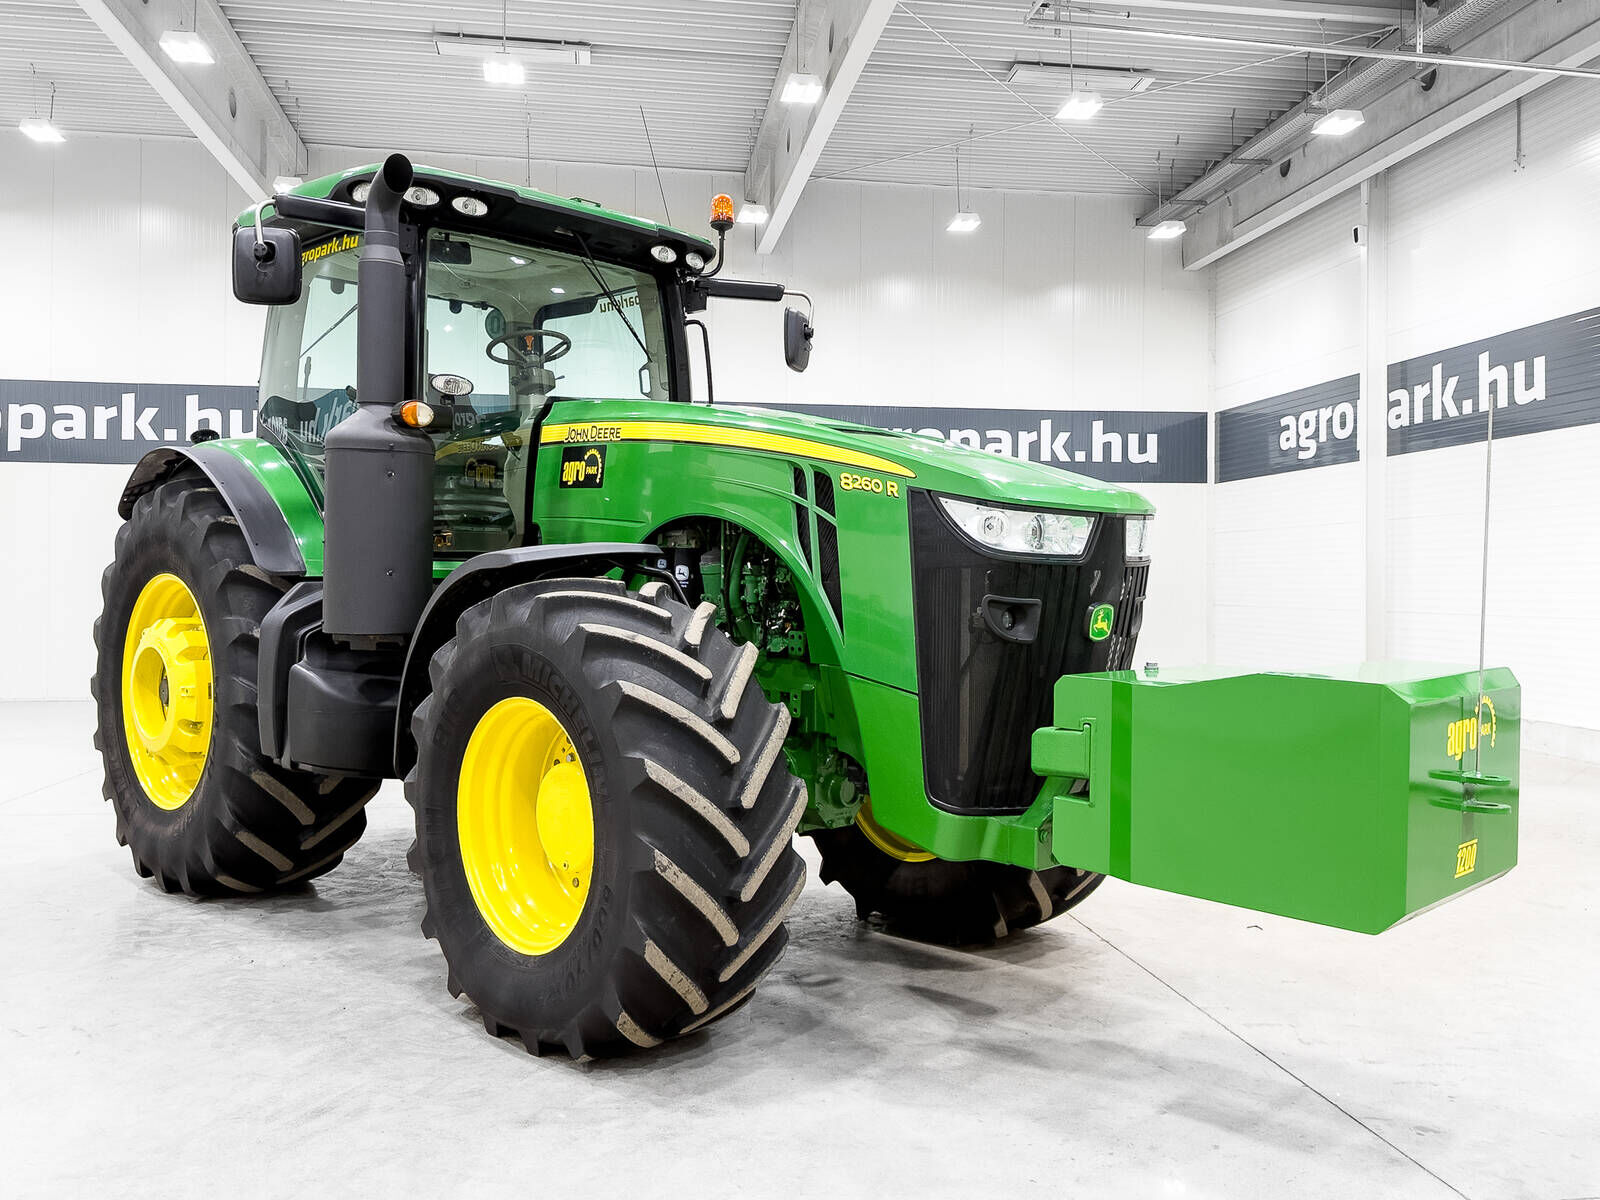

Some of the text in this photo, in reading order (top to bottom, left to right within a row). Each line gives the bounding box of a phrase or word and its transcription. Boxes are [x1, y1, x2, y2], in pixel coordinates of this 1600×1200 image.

[0, 392, 258, 452] park.hu
[564, 425, 622, 442] JOHN DEERE
[562, 460, 586, 485] agro
[839, 472, 899, 498] 8260 R
[1446, 717, 1478, 760] agro
[1456, 843, 1477, 873] 1200
